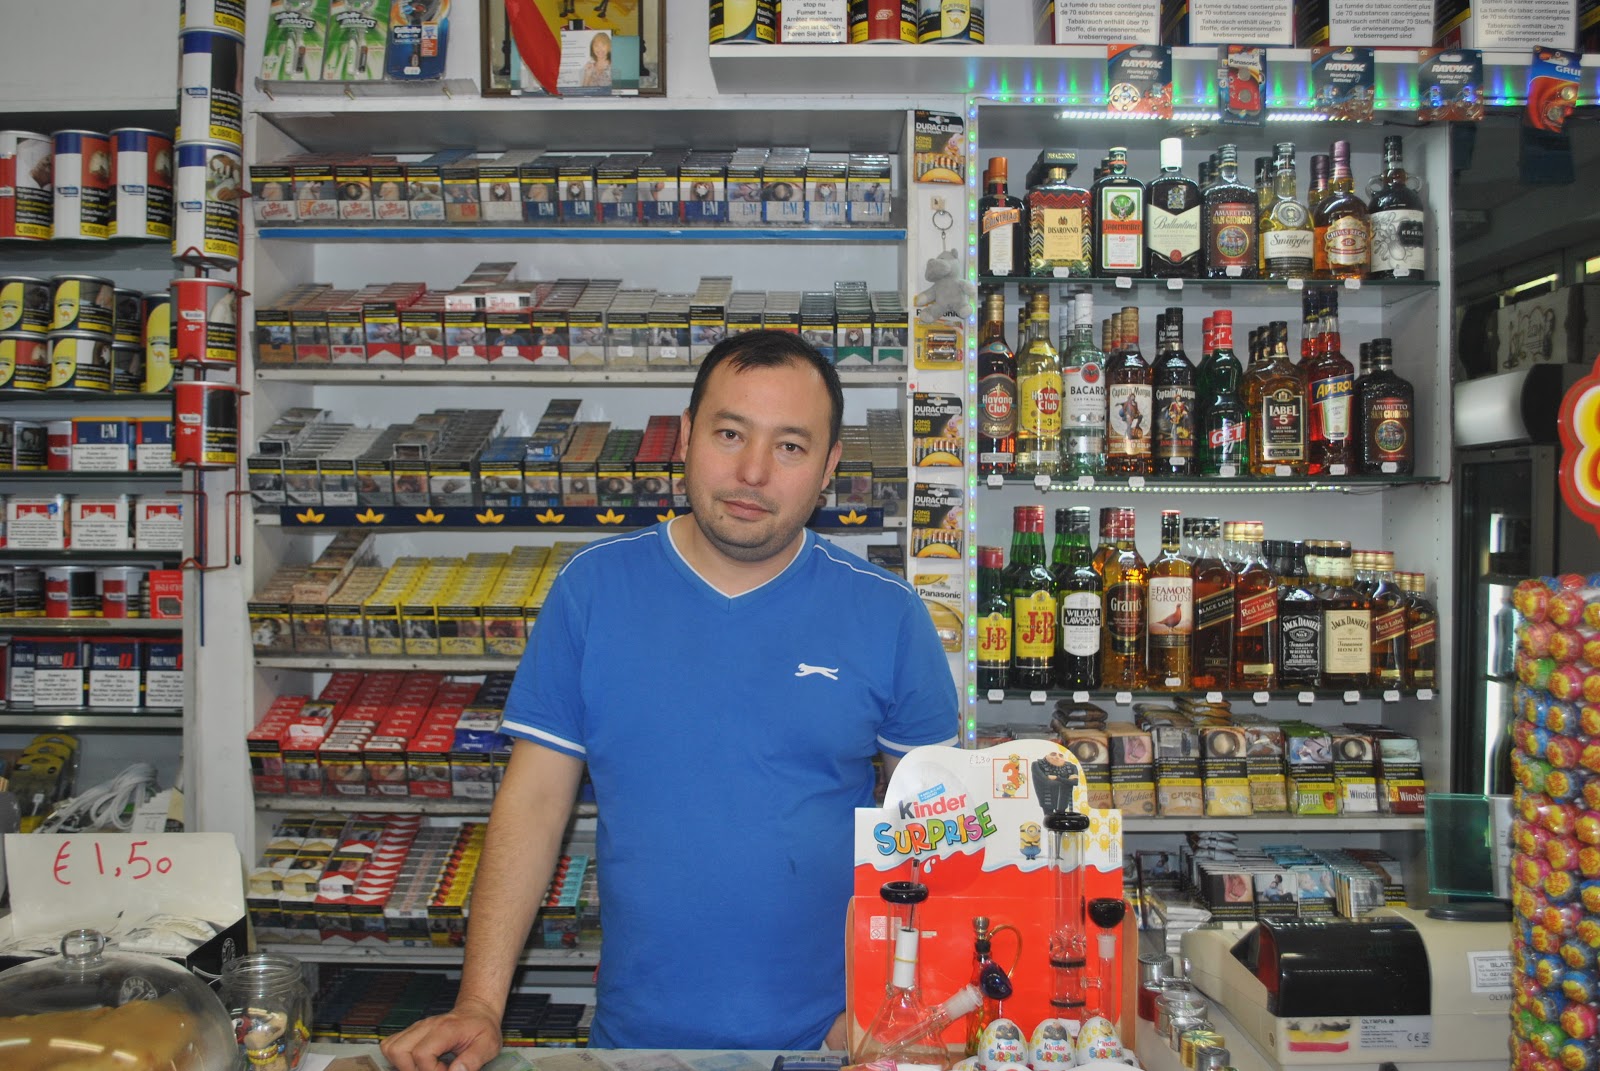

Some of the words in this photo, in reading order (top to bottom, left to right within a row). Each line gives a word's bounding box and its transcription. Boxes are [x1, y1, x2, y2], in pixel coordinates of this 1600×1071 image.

[1194, 3, 1202, 12] La
[1203, 4, 1222, 12] fumée
[1331, 17, 1367, 25] Tabakrauch
[1220, 25, 1230, 33] die
[1506, 29, 1515, 37] die
[1399, 31, 1413, 39] sind
[1122, 60, 1163, 69] RAYOVAC
[1229, 58, 1258, 66] Panasonic
[1325, 63, 1365, 72] RAYOVAC
[1432, 64, 1472, 72] RAYOVAC
[1104, 223, 1140, 231] Jägermeister
[1153, 216, 1198, 230] Ballantine's
[1048, 226, 1079, 234] DISARONNO
[1327, 229, 1349, 239] CHIVAS
[1112, 387, 1132, 398] Captain
[1156, 388, 1173, 399] Captain
[1174, 387, 1195, 399] Morgan
[982, 395, 1012, 404] Havana
[988, 405, 1007, 413] Club
[1038, 401, 1057, 410] Club
[1269, 405, 1299, 416] LABEL
[1047, 418, 1052, 426] 3
[1280, 415, 1288, 424] 5
[1212, 426, 1244, 445] GET
[920, 588, 961, 598] Panasonic
[1156, 586, 1191, 594] FAMOUS
[1110, 597, 1142, 612] Grant's
[1242, 607, 1255, 617] Red
[1257, 600, 1274, 610] Label
[1066, 609, 1099, 618] WILLIAM
[1064, 617, 1100, 626] LAWSON'S
[1283, 619, 1297, 631] JACK
[1332, 619, 1346, 630] JACK
[1376, 623, 1386, 631] Red
[1387, 617, 1404, 627] Label
[1022, 612, 1054, 644] J&B
[982, 628, 1007, 650] J&B
[1350, 791, 1376, 800] Winston
[898, 794, 966, 819] Kinder
[874, 802, 997, 856] SURPRISE
[53, 841, 71, 885] €
[94, 840, 172, 879] 1,50
[988, 1049, 1024, 1062] SURPRISE
[1036, 1049, 1071, 1062] SURPRISE
[1089, 1047, 1122, 1059] SURPRISE
